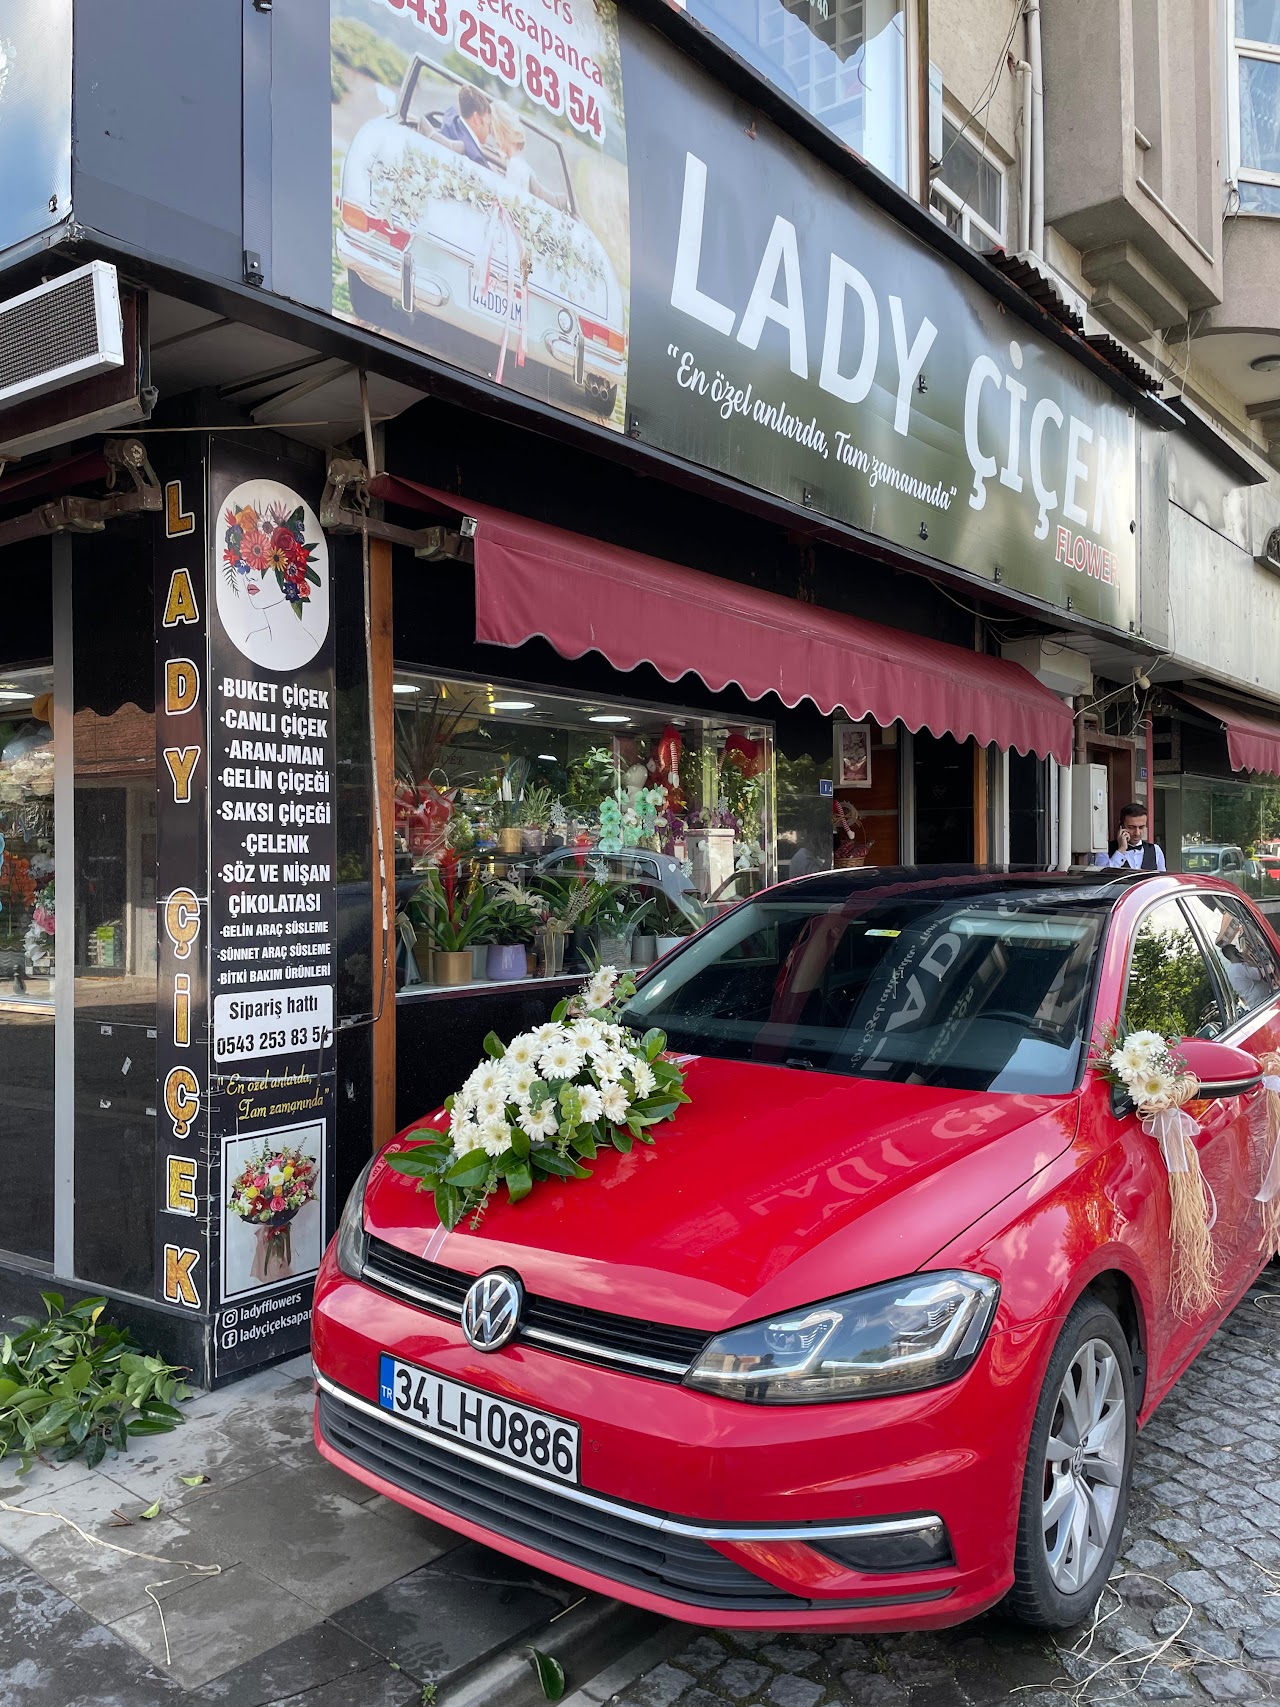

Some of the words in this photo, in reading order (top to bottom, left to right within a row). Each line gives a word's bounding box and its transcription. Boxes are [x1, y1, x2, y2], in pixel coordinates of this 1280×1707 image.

[477, 0, 603, 87] eksapanca
[459, 9, 516, 80] 253
[526, 53, 560, 109] 83
[569, 81, 602, 137] 54
[671, 151, 938, 437] LADY
[964, 340, 1123, 545] ÇİÇEK
[710, 370, 753, 419] özel
[753, 399, 829, 459] anlarda,
[834, 430, 870, 474] Tam
[223, 677, 278, 703] BUKET
[282, 683, 329, 711] ÇİÇEK
[225, 708, 276, 733] CANLI
[281, 713, 328, 739] ÇİÇEK
[229, 739, 324, 766] ARANJMAN
[222, 766, 273, 789] GELİN
[277, 768, 330, 795] ÇİÇEĞİ
[221, 801, 274, 822] SAKSI
[278, 800, 331, 827] ÇİÇEĞİ
[246, 833, 310, 857] ÇELENK
[222, 861, 255, 883] SÖZ
[260, 864, 279, 882] VE
[283, 862, 331, 886] NİŞAN
[228, 891, 321, 918] ÇİKOLATASI
[222, 922, 254, 938] GELİN
[255, 923, 283, 938] ARAÇ
[285, 920, 329, 935] SÜSLEME
[261, 945, 288, 960] ARAÇ
[289, 942, 331, 957] SÜSLEME
[249, 966, 283, 983] BAKIM
[285, 962, 331, 979] ÜRÜNLERİ
[229, 996, 283, 1021] Sipariş
[287, 995, 318, 1014] hattı
[217, 1034, 254, 1056] 0543
[259, 1030, 286, 1050] 253
[291, 1028, 308, 1046] 83
[312, 1025, 329, 1043] 54
[238, 1098, 267, 1121] Tam
[241, 1292, 302, 1321] ladyfflowers
[381, 1384, 393, 1401] TR
